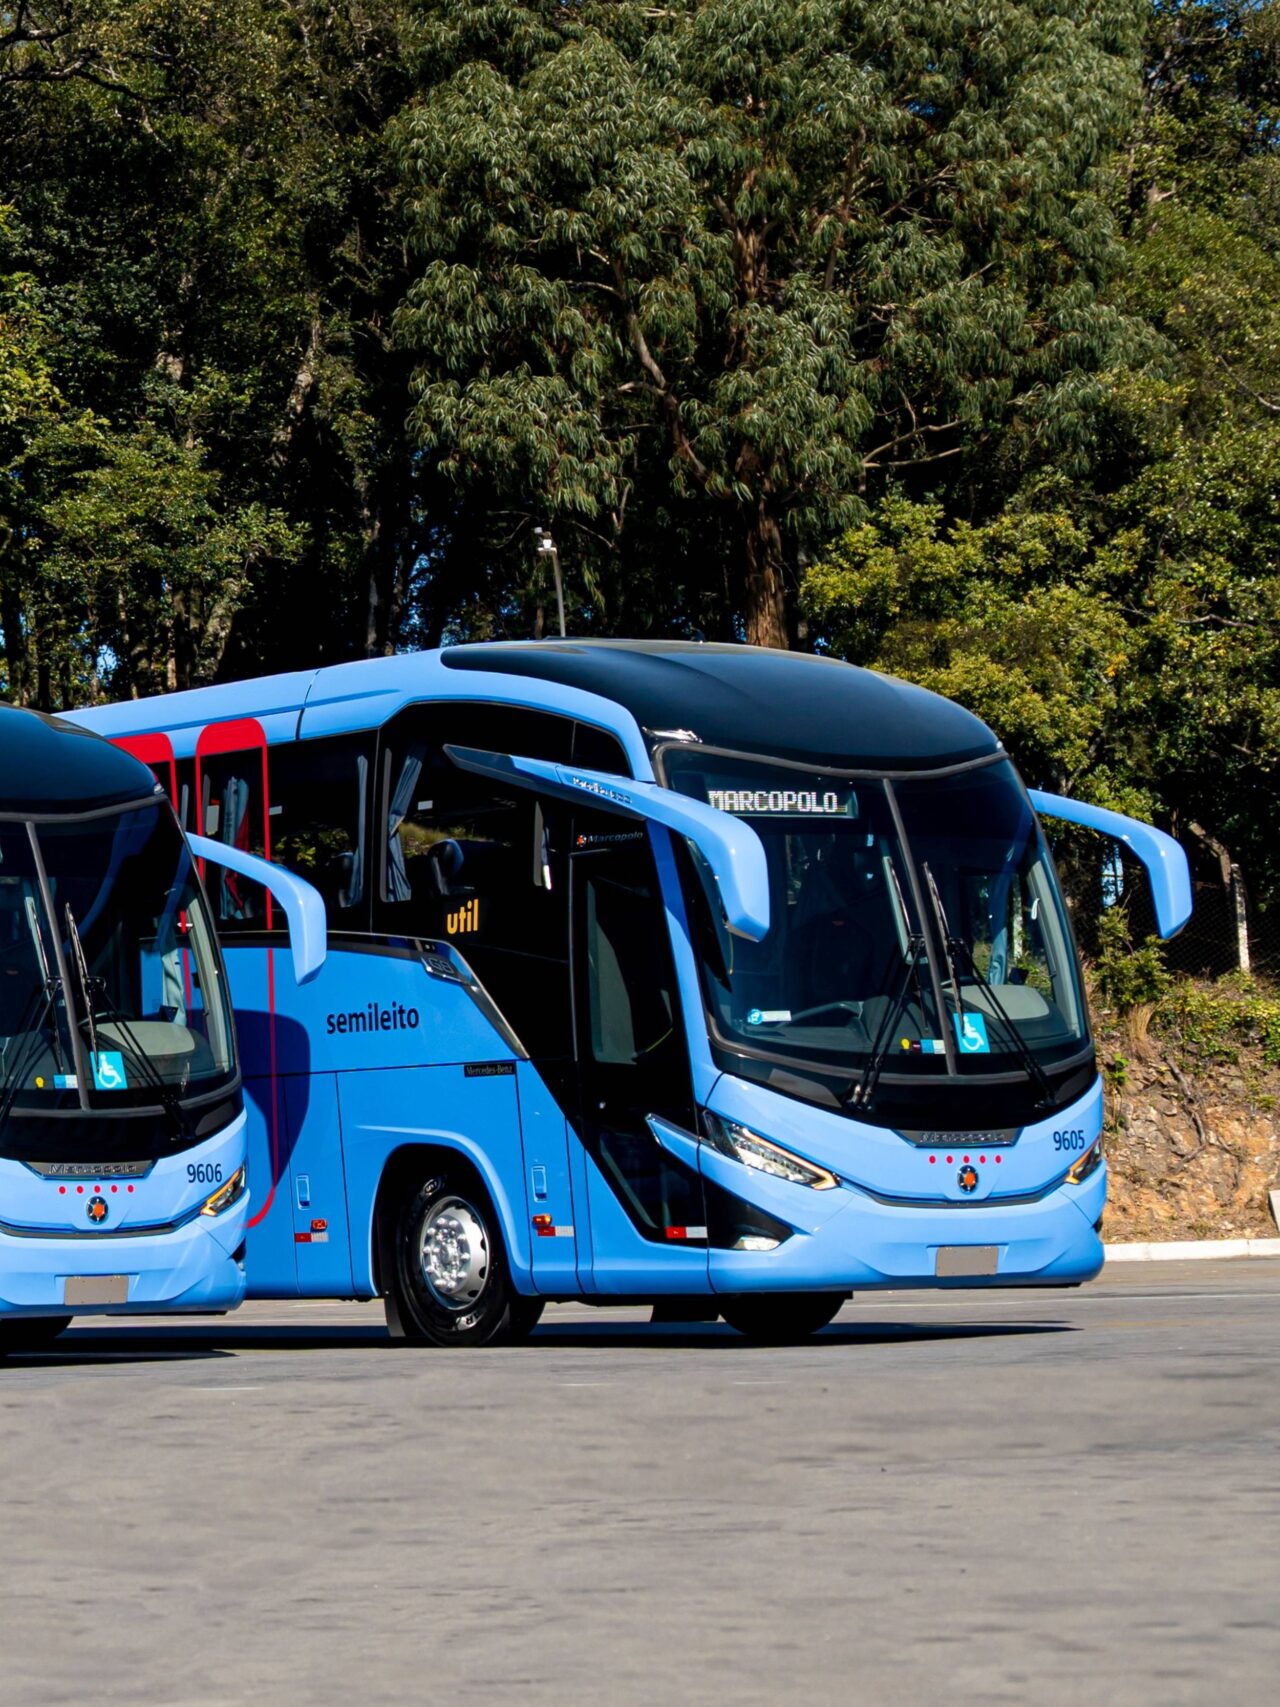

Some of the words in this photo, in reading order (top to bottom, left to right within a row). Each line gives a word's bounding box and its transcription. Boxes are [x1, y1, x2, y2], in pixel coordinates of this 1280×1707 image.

[708, 790, 838, 812] MARCOPOLO
[447, 899, 479, 934] util
[326, 1001, 420, 1035] semileito
[466, 1064, 513, 1076] Mercedes-Benz
[1053, 1130, 1085, 1151] 9605
[186, 1163, 223, 1183] 9606
